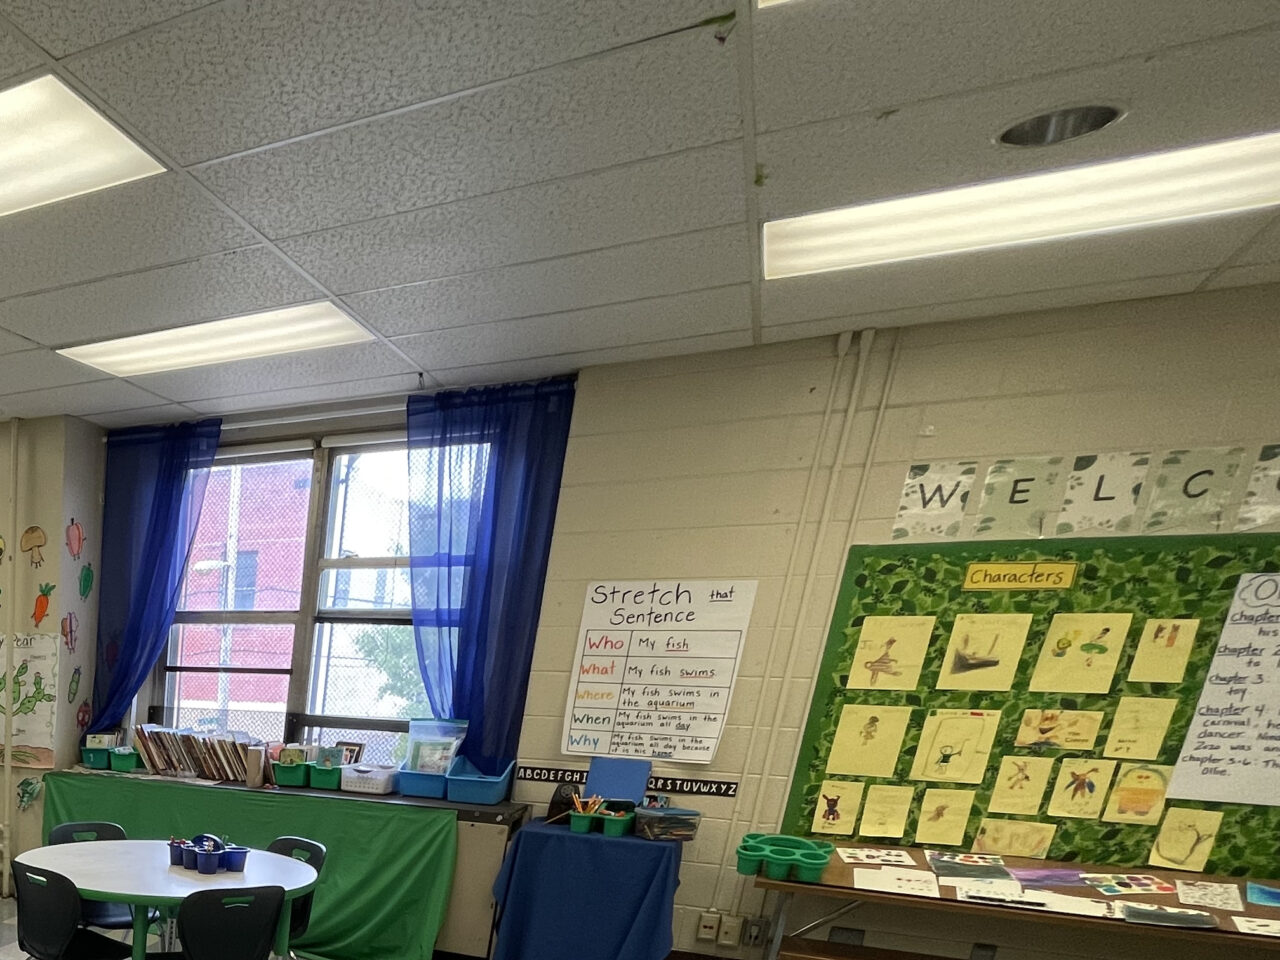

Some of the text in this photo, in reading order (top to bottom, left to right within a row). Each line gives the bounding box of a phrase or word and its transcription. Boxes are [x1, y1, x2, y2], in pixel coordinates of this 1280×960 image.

[970, 564, 1064, 586] Characters
[591, 583, 735, 606] Stretch that
[609, 607, 696, 627] Sentence
[588, 635, 689, 651] Who My fish
[627, 666, 643, 678] My
[650, 664, 670, 676] fish
[622, 687, 636, 697] My
[642, 686, 660, 696] fish
[669, 689, 701, 697] swims
[622, 699, 695, 710] the aquarium
[573, 714, 611, 725] When
[619, 712, 630, 720] My
[636, 711, 652, 720] fish
[703, 714, 718, 722] the
[616, 720, 654, 728] aquarium
[570, 735, 600, 749] Why
[613, 733, 624, 741] My
[628, 733, 643, 741] fish
[611, 740, 645, 748] aquarium
